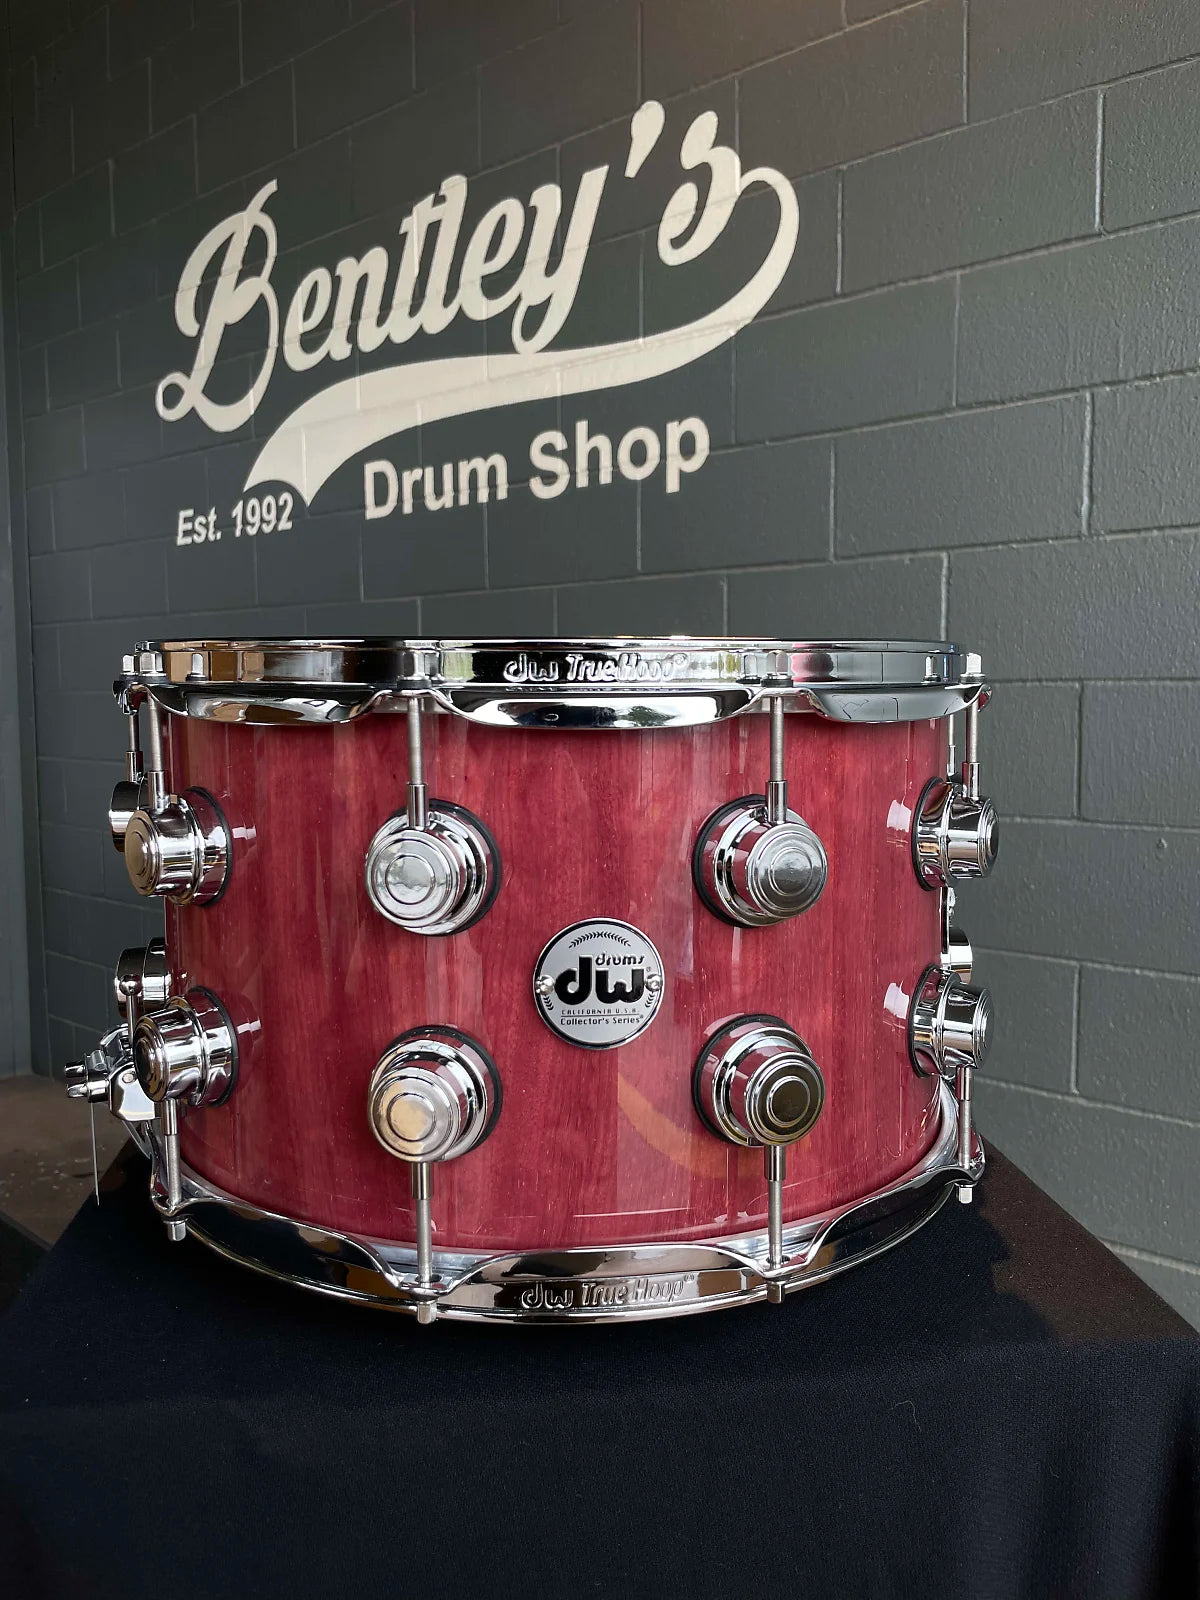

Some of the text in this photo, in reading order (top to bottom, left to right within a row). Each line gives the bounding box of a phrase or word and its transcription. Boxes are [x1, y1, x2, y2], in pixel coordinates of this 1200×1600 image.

[156, 100, 745, 433] Bentley's
[364, 415, 710, 520] Drum Shop
[176, 491, 294, 546] Est. 1992
[503, 653, 559, 682] dw
[595, 953, 645, 966] drums
[554, 955, 645, 1005] dw
[560, 1016, 610, 1026] Collector's
[521, 1281, 574, 1309] dw
